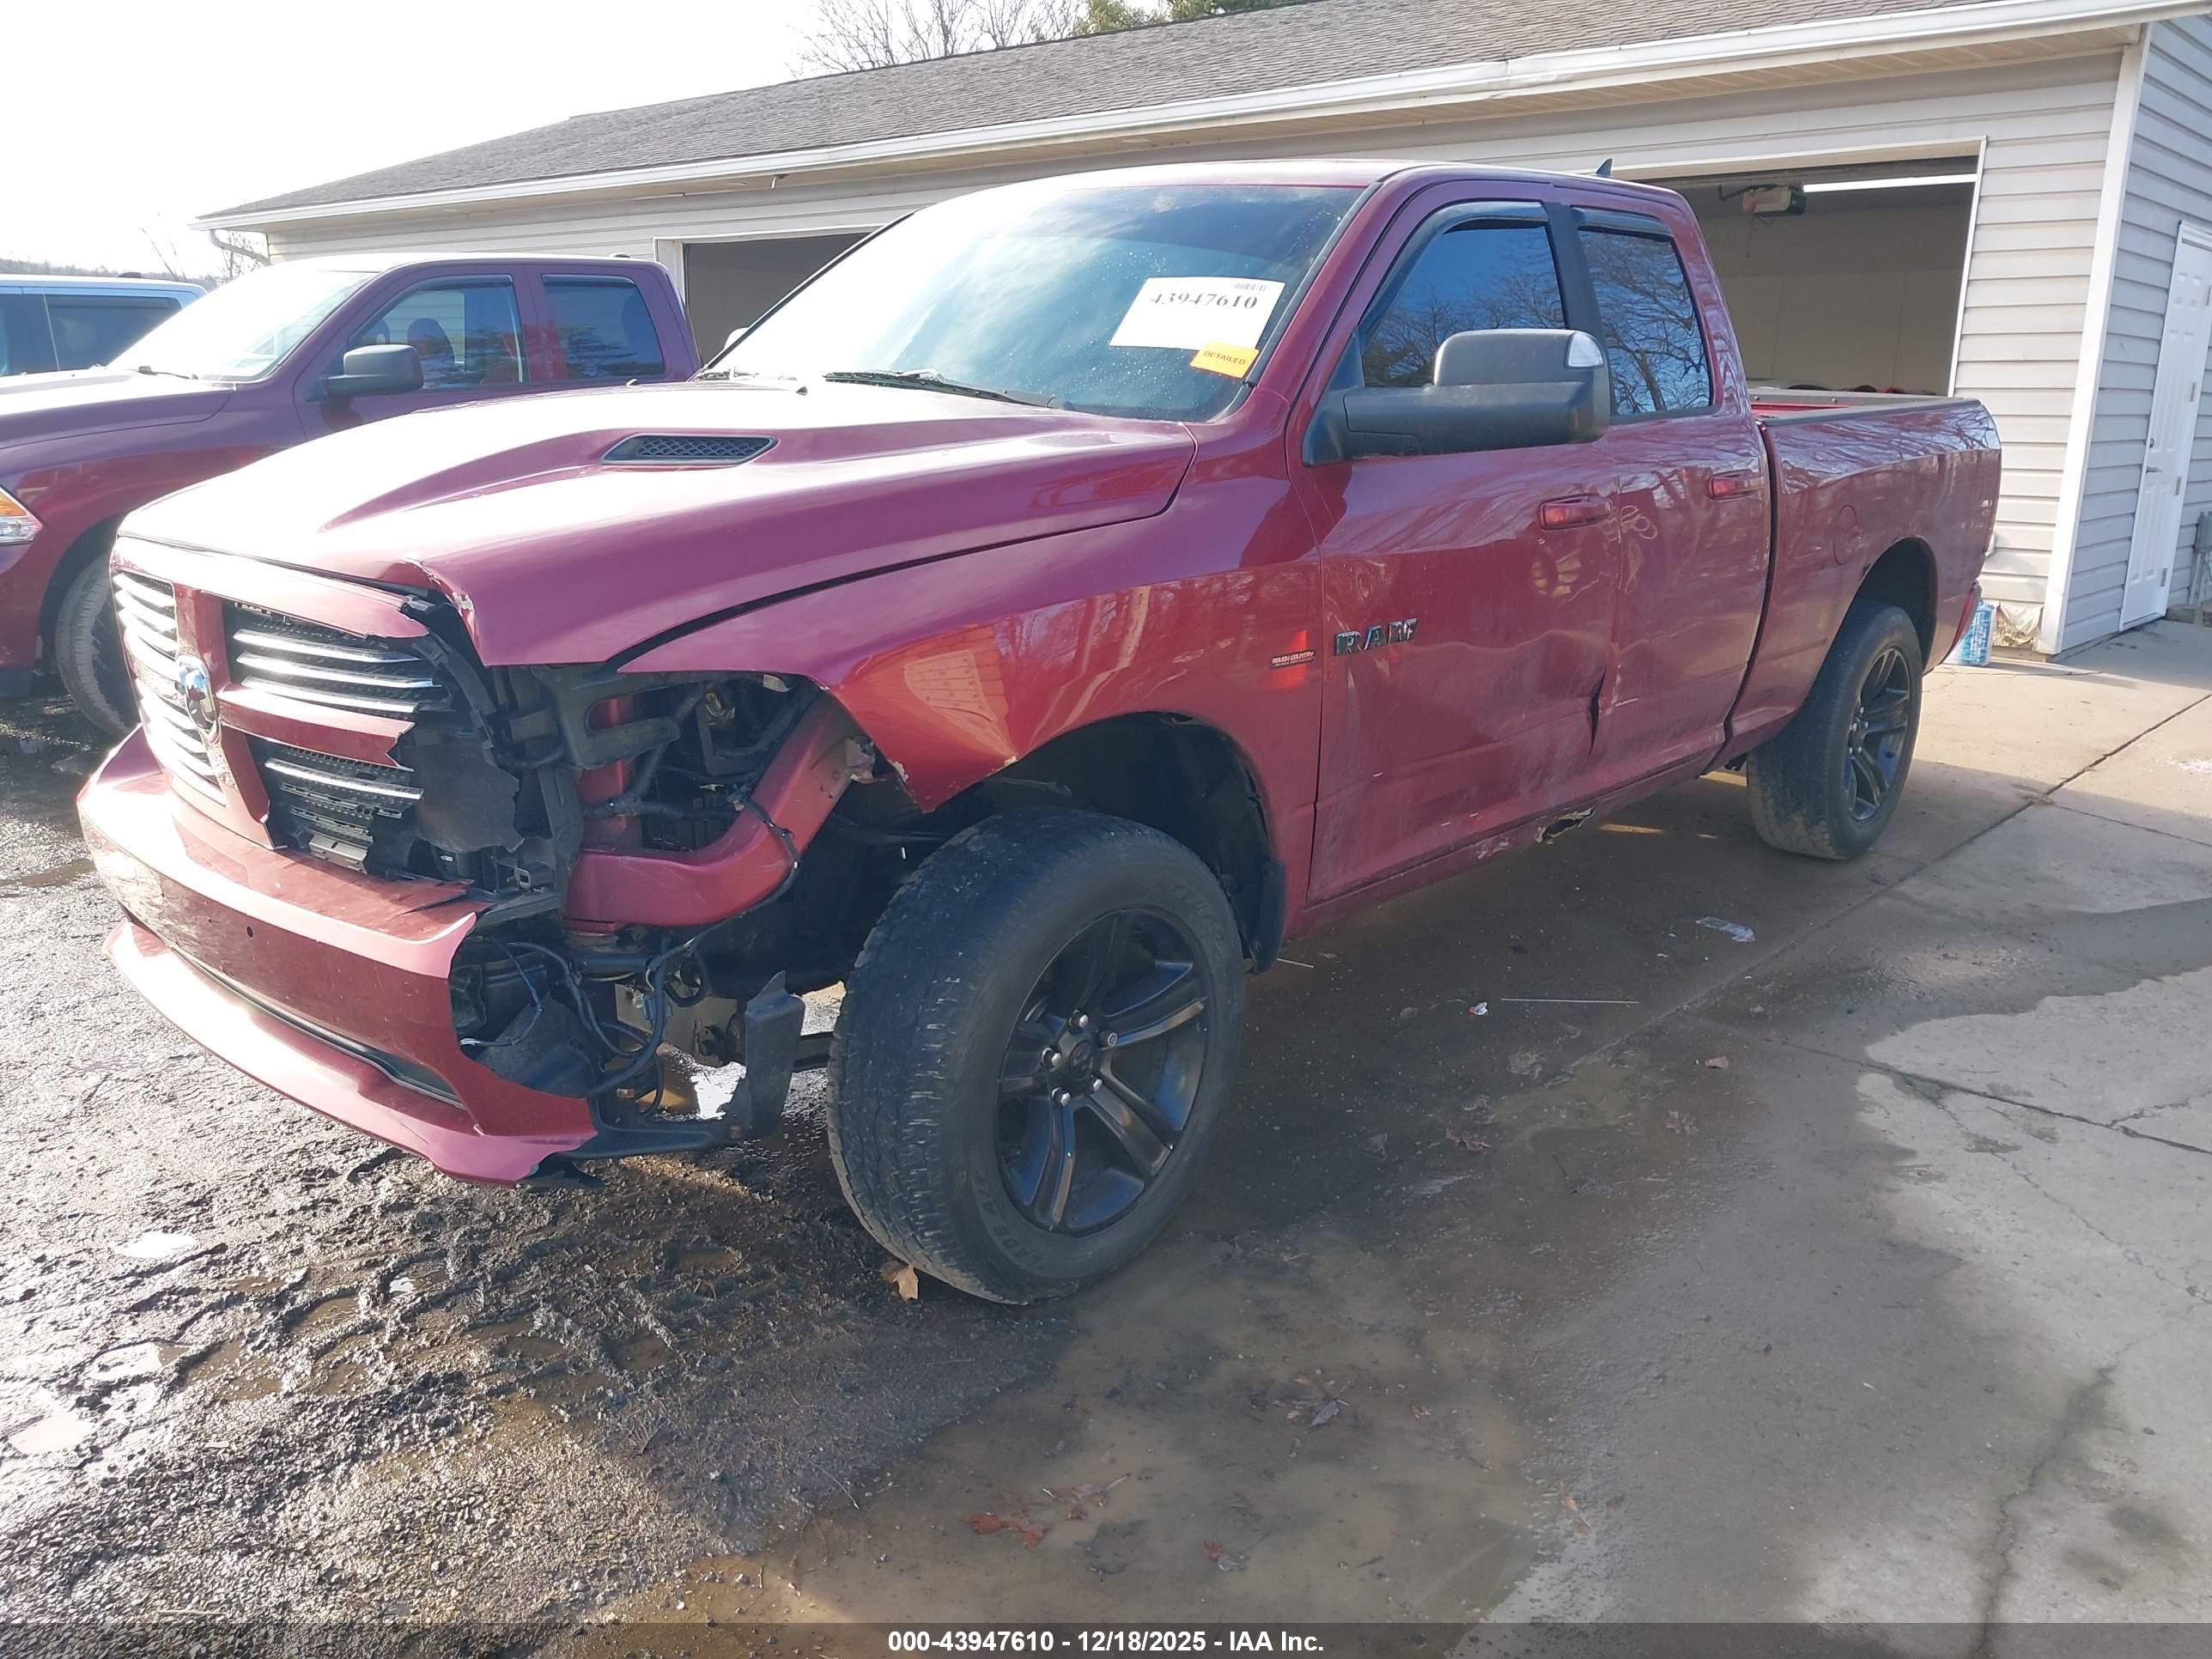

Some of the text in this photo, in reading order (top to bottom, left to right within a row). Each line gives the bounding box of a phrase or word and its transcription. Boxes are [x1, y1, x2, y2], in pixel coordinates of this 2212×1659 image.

[1150, 292, 1258, 309] 43947610
[1204, 349, 1246, 366] DETAILED
[1334, 617, 1418, 657] RAM
